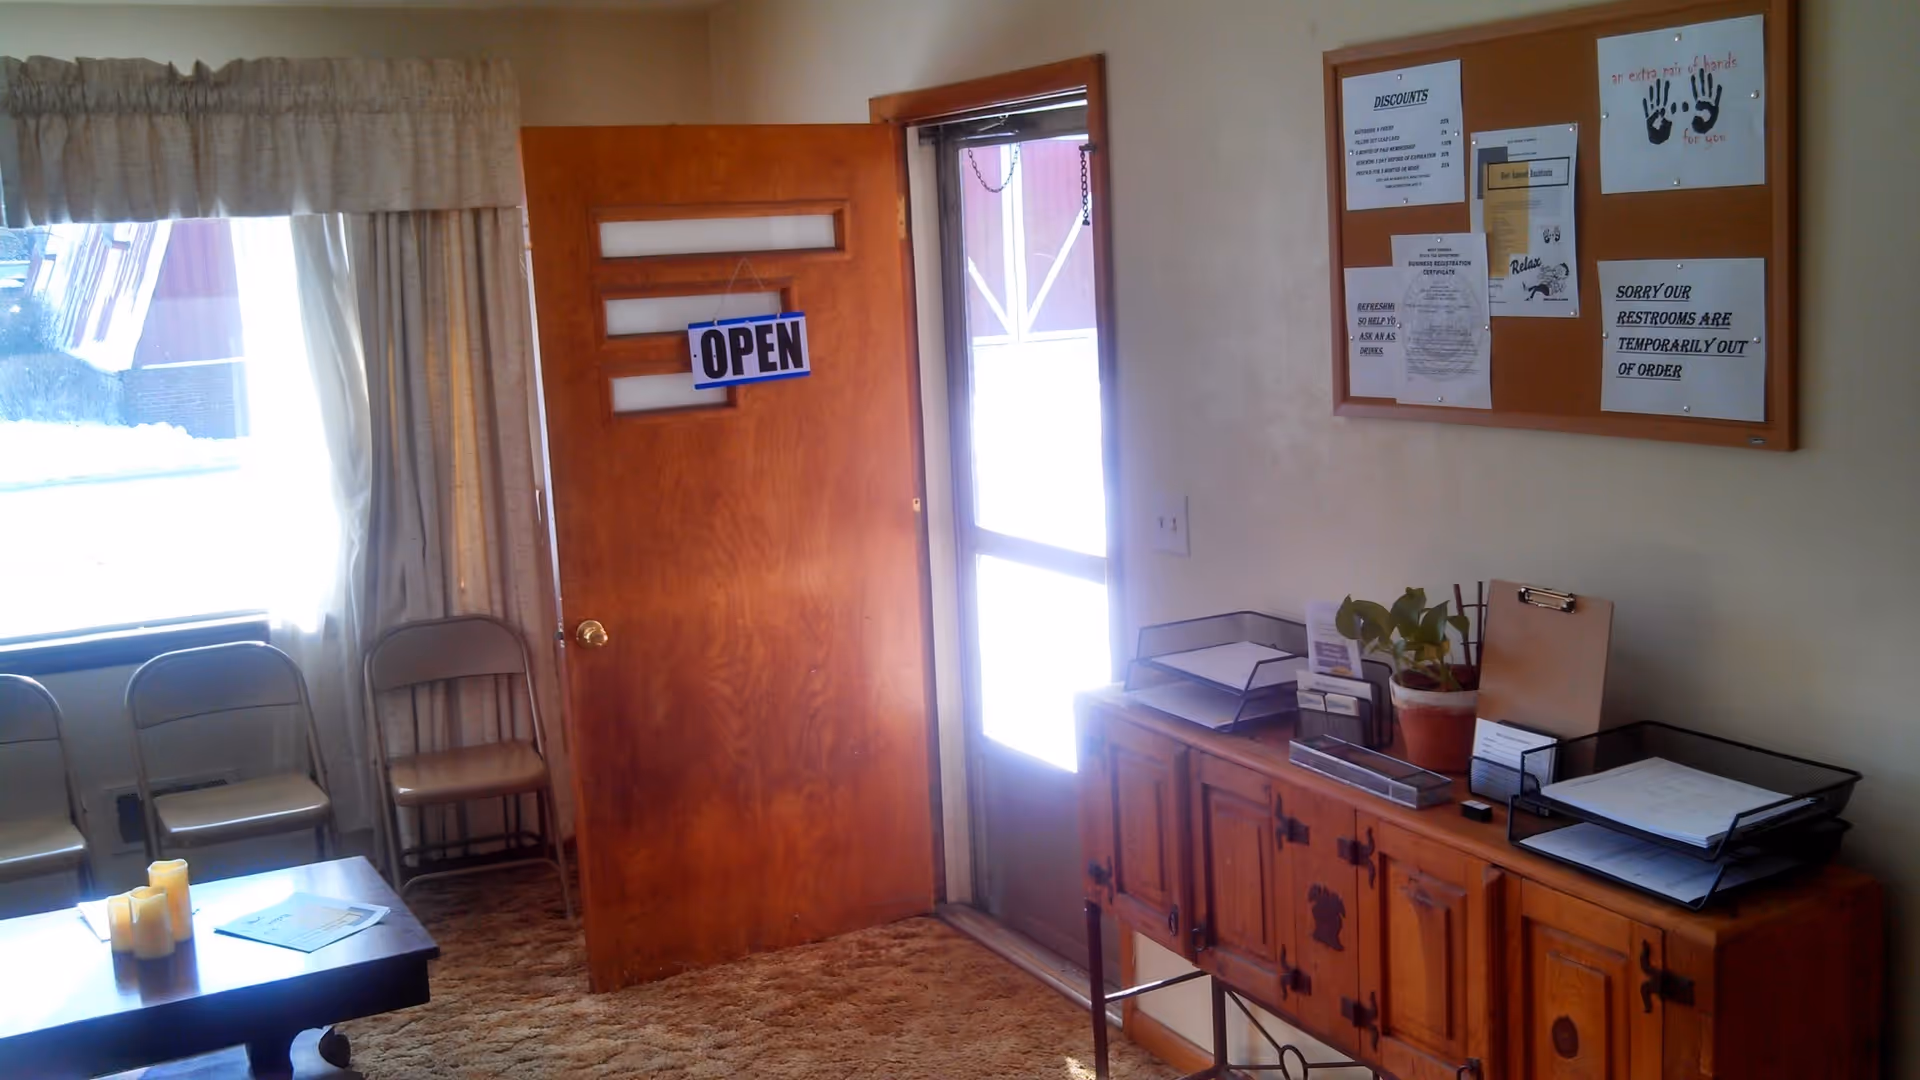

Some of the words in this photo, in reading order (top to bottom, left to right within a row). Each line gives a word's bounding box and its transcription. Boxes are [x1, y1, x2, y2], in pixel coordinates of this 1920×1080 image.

[1611, 73, 1623, 84] an
[1628, 66, 1657, 82] extra
[1663, 62, 1682, 79] pair
[1688, 55, 1699, 73] of
[1703, 52, 1738, 71] hands
[1373, 88, 1430, 109] DISCOUNTS
[1683, 128, 1699, 145] for
[1705, 134, 1726, 149] you
[1510, 256, 1542, 275] Relax
[1615, 283, 1665, 299] SORRY
[1663, 285, 1692, 300] OUR
[1358, 317, 1367, 326] SO
[1368, 316, 1386, 326] HELP
[1616, 311, 1697, 326] RESTROOMS
[1699, 312, 1733, 327] ARE
[1359, 333, 1374, 341] ASK
[1374, 332, 1385, 341] AN
[700, 320, 804, 379] OPEN
[1618, 337, 1717, 353] TEMPORARILY
[1716, 340, 1749, 354] OUT
[1617, 362, 1637, 376] OF
[1637, 363, 1683, 378] ORDER
